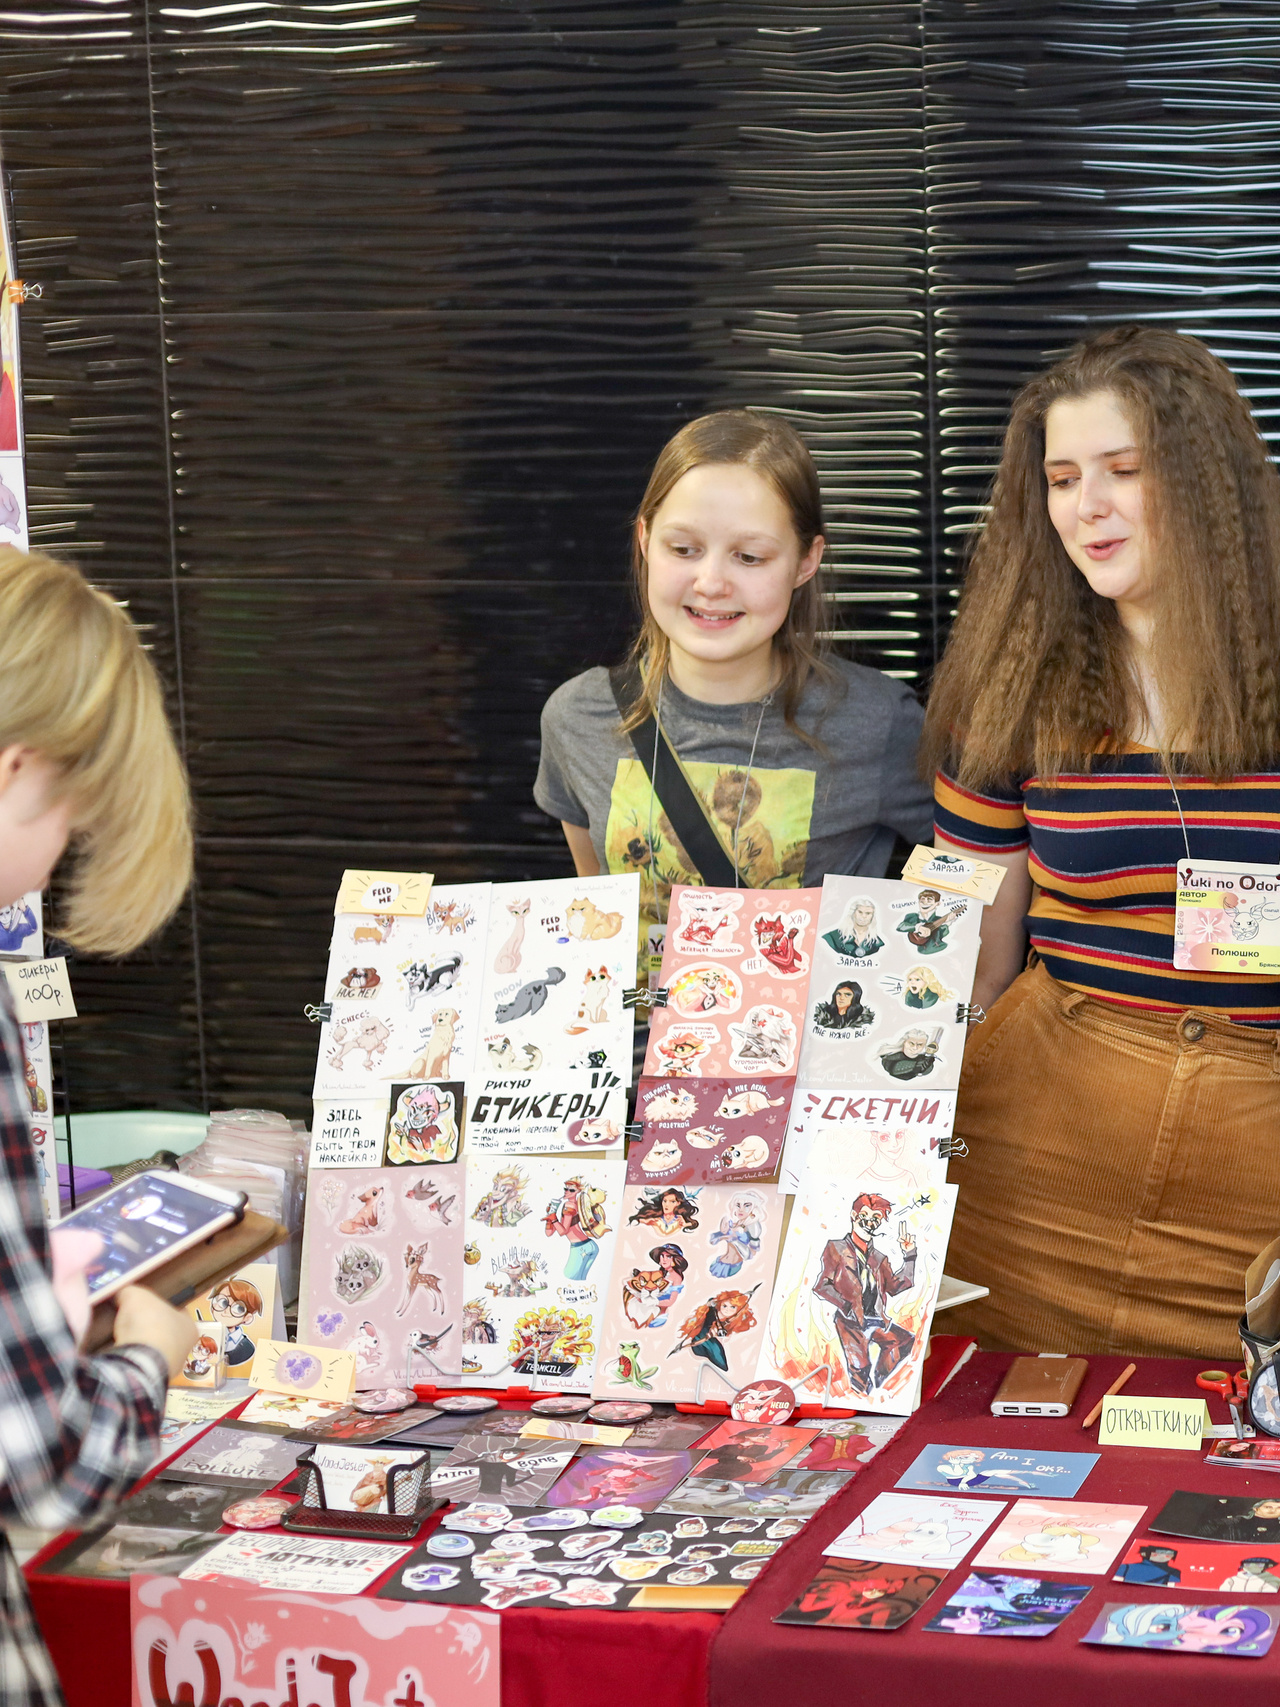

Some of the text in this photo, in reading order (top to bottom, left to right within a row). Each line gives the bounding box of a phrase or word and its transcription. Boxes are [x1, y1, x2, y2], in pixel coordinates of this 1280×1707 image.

[1178, 871, 1211, 888] Yuki
[1216, 880, 1234, 889] no
[372, 886, 392, 897] FEED
[540, 916, 560, 926] FEED
[1211, 948, 1259, 958] Полюшко
[336, 988, 355, 998] HUG
[493, 979, 523, 1001] MOON
[812, 1026, 827, 1037] МНЕ
[828, 1028, 851, 1039] НУЖНО
[484, 1078, 532, 1091] РИСУЮ
[734, 1084, 748, 1092] МНЕ
[470, 1091, 610, 1124] СТИКЕРЫ
[821, 1096, 941, 1125] СКЕТЧИ
[326, 1108, 363, 1123] ЗДЕСЬ
[658, 1119, 690, 1129] РОЗЕТКОЙ
[321, 1127, 361, 1139] МОГЛА
[315, 1140, 377, 1152] БЫТЬ ТВОЯ
[770, 1401, 790, 1409] HELLO
[1106, 1407, 1181, 1434] ОТКРЫТКИ
[517, 1456, 558, 1467] BOMB
[989, 1452, 1019, 1461] Am
[1021, 1457, 1036, 1466] I
[257, 1551, 370, 1569] ЛОТЕРЕЯ!
